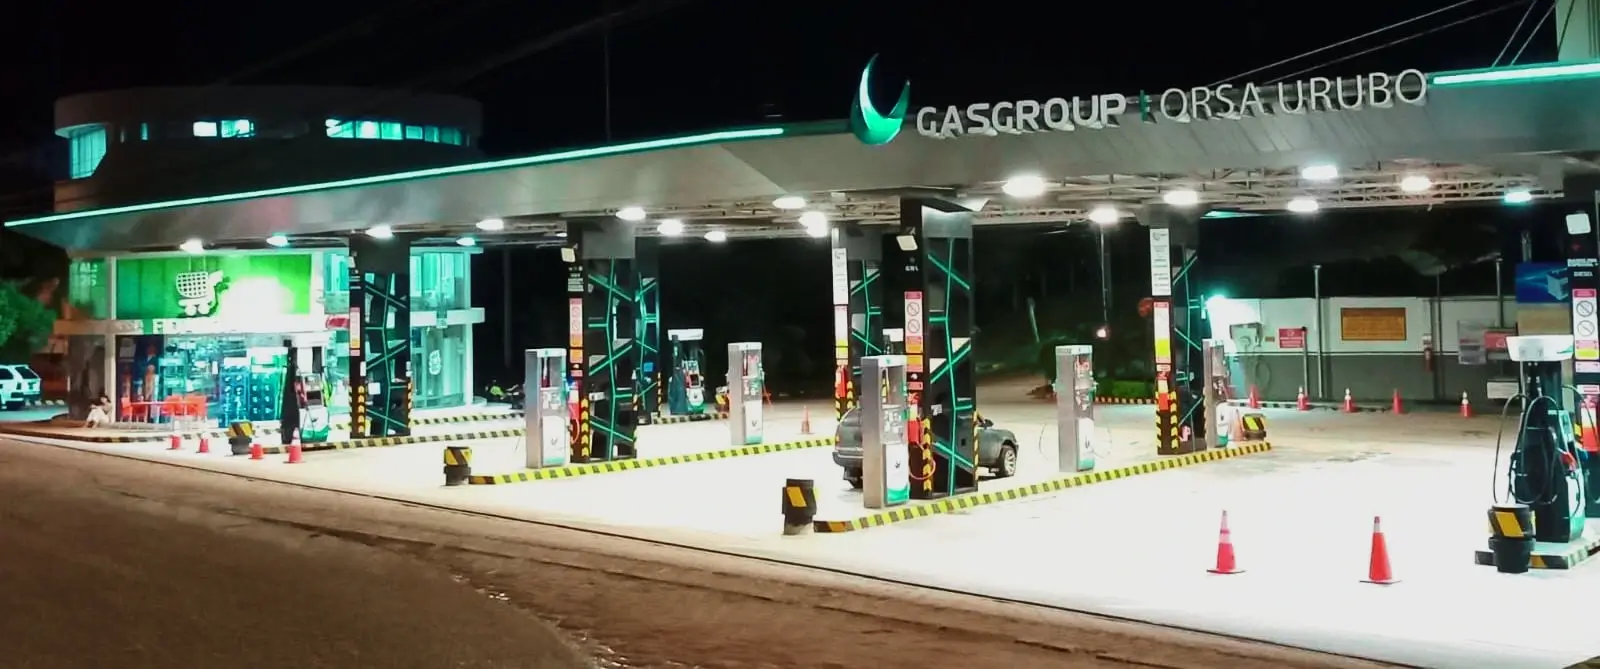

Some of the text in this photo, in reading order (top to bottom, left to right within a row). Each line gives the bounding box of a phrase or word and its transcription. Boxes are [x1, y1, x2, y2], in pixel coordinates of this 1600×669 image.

[916, 69, 1427, 137] GASGROUP ORSA URUBO
